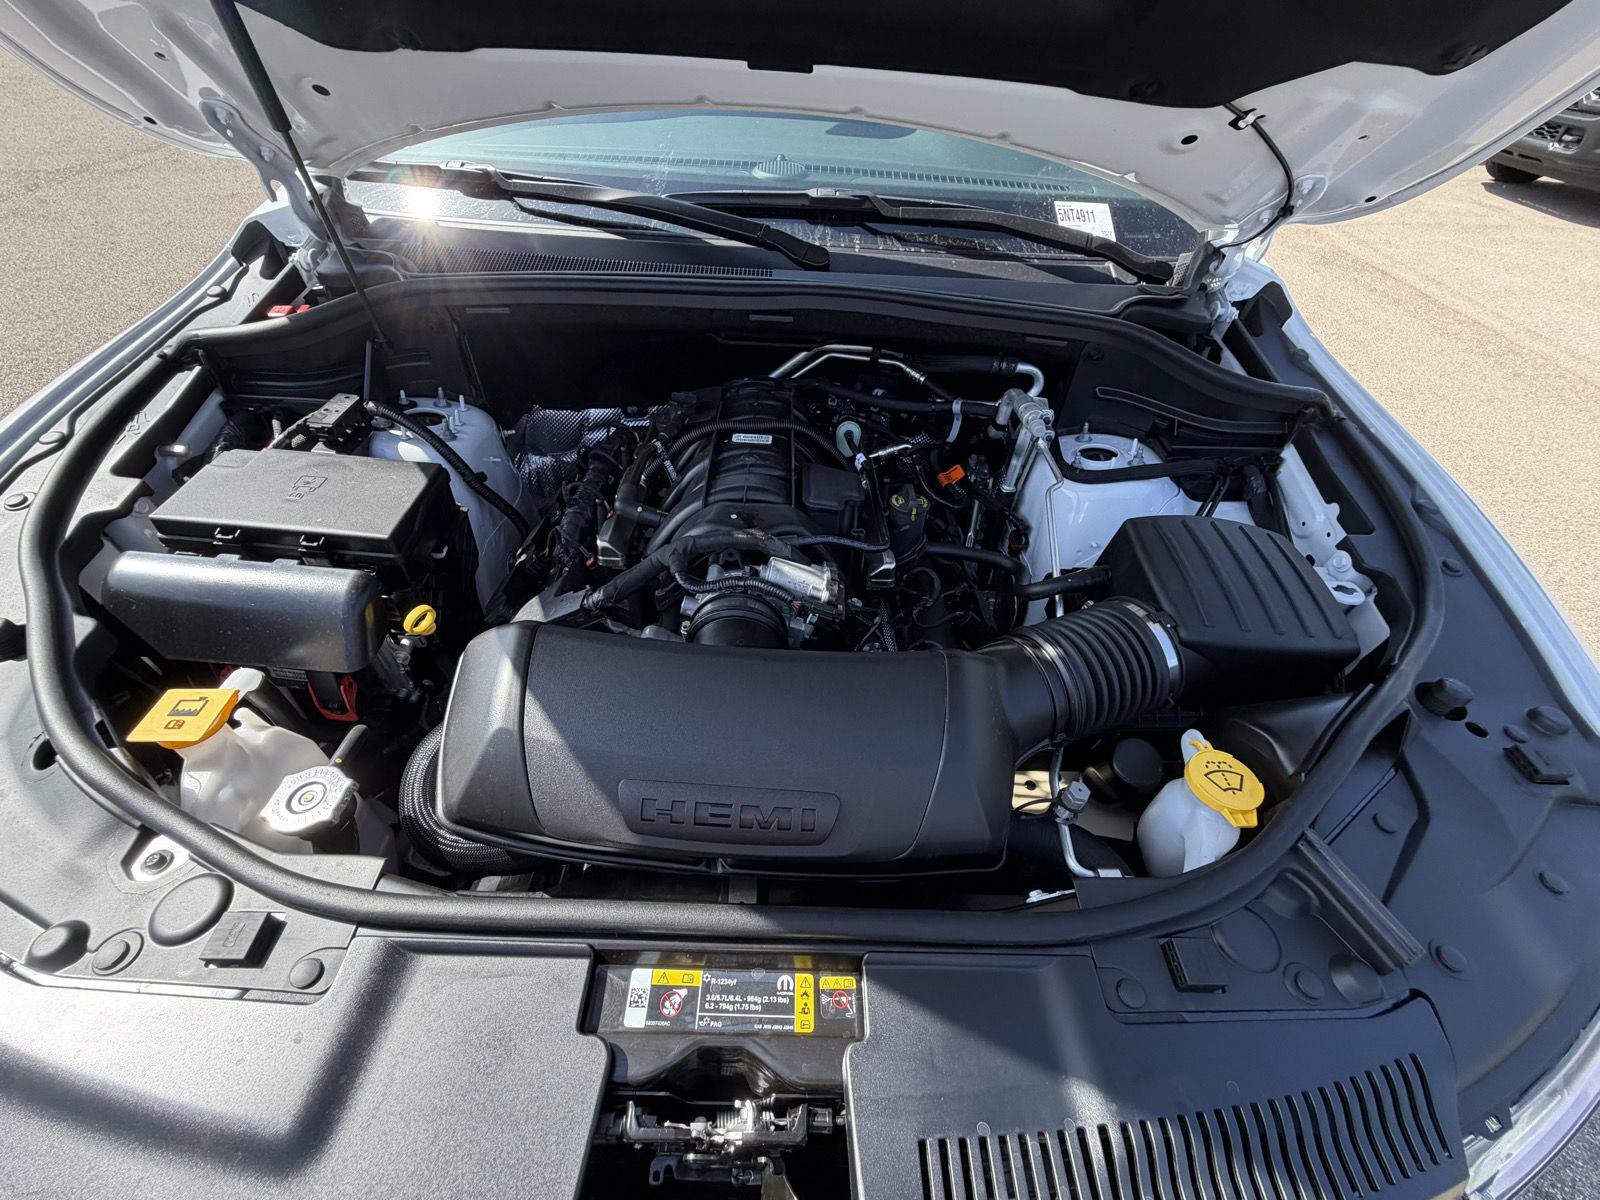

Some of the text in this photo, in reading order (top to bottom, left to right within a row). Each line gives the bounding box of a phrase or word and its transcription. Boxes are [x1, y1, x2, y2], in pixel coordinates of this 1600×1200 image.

[1057, 208, 1096, 222] 5NT4911
[640, 797, 817, 833] HEMI
[711, 978, 737, 987] R-1234yf
[778, 996, 789, 1005] lbs)
[750, 1004, 761, 1012] lbs)
